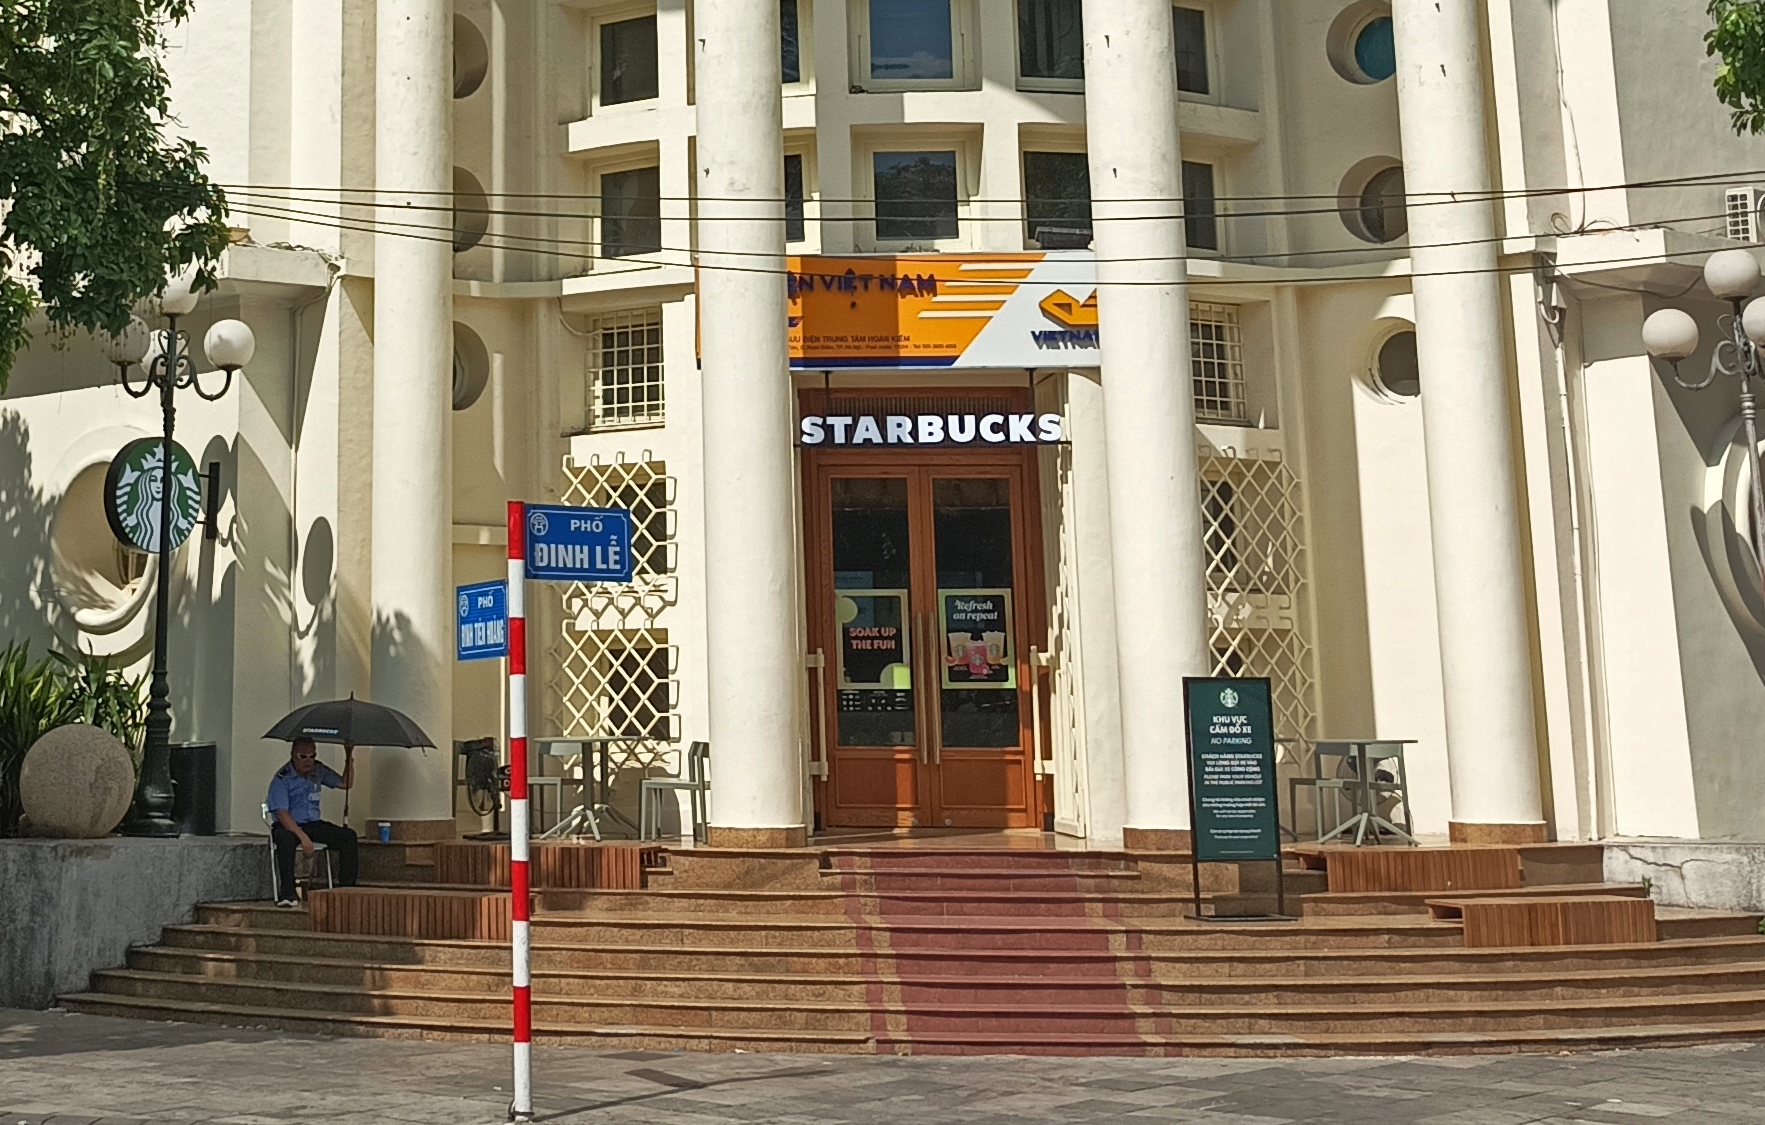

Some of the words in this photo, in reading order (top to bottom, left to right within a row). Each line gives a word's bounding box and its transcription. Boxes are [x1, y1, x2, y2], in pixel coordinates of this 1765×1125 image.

[880, 274, 938, 296] NAM
[801, 413, 1063, 444] STARBUCKS
[570, 516, 604, 533] PHỐ
[534, 542, 589, 569] ĐINH
[595, 534, 621, 570] LỄ
[477, 590, 494, 609] PHỐ
[954, 600, 993, 612] Refresh
[953, 611, 966, 620] on
[966, 611, 998, 622] repeat
[849, 627, 880, 637] SOAK
[880, 627, 897, 637] UP
[851, 639, 872, 650] THE
[873, 639, 896, 650] FUN
[1212, 715, 1231, 724] KHU
[1242, 725, 1252, 734] XE
[1210, 737, 1223, 745] NO
[1222, 737, 1253, 745] PARKING
